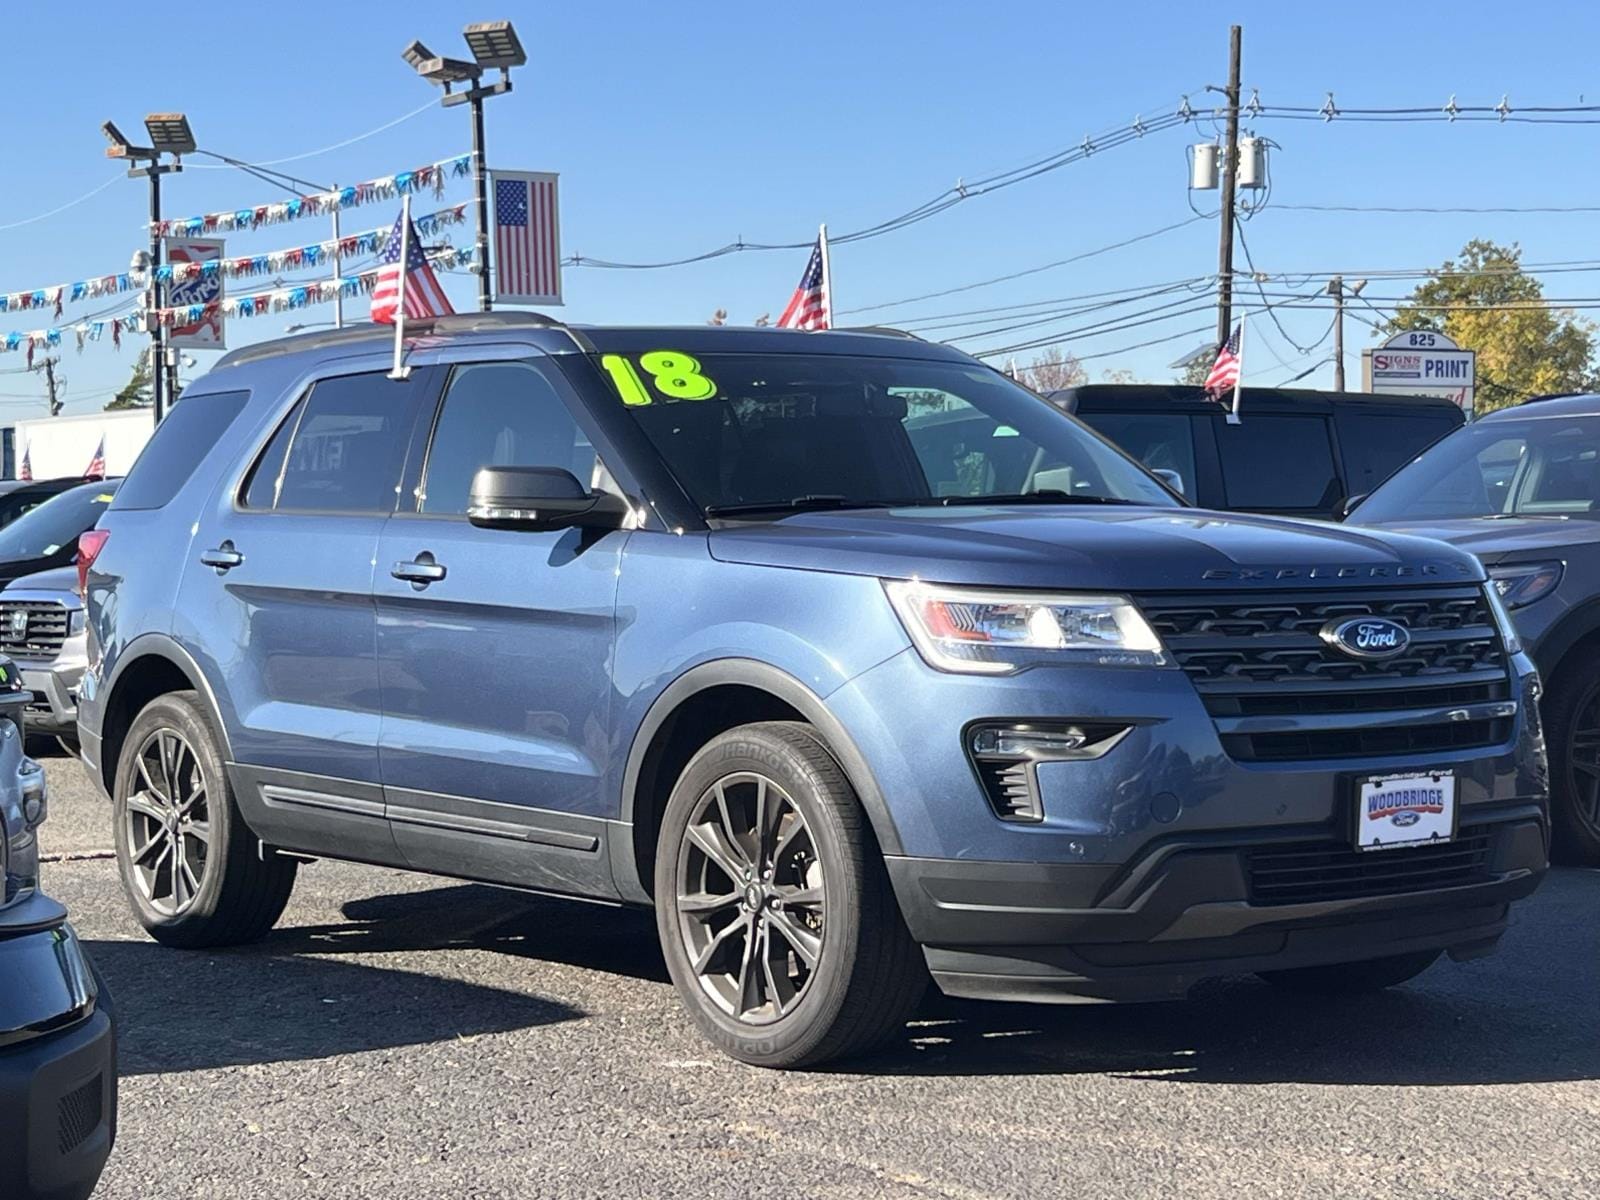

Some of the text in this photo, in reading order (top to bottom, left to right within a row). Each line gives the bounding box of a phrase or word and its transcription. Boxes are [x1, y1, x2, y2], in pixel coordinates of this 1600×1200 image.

[1409, 333, 1436, 347] 825
[601, 351, 718, 406] 18
[1425, 359, 1469, 378] PRINT
[1202, 564, 1439, 580] EXPLORER
[1356, 623, 1397, 648] Ford
[1368, 788, 1443, 814] WOODBRIDGE
